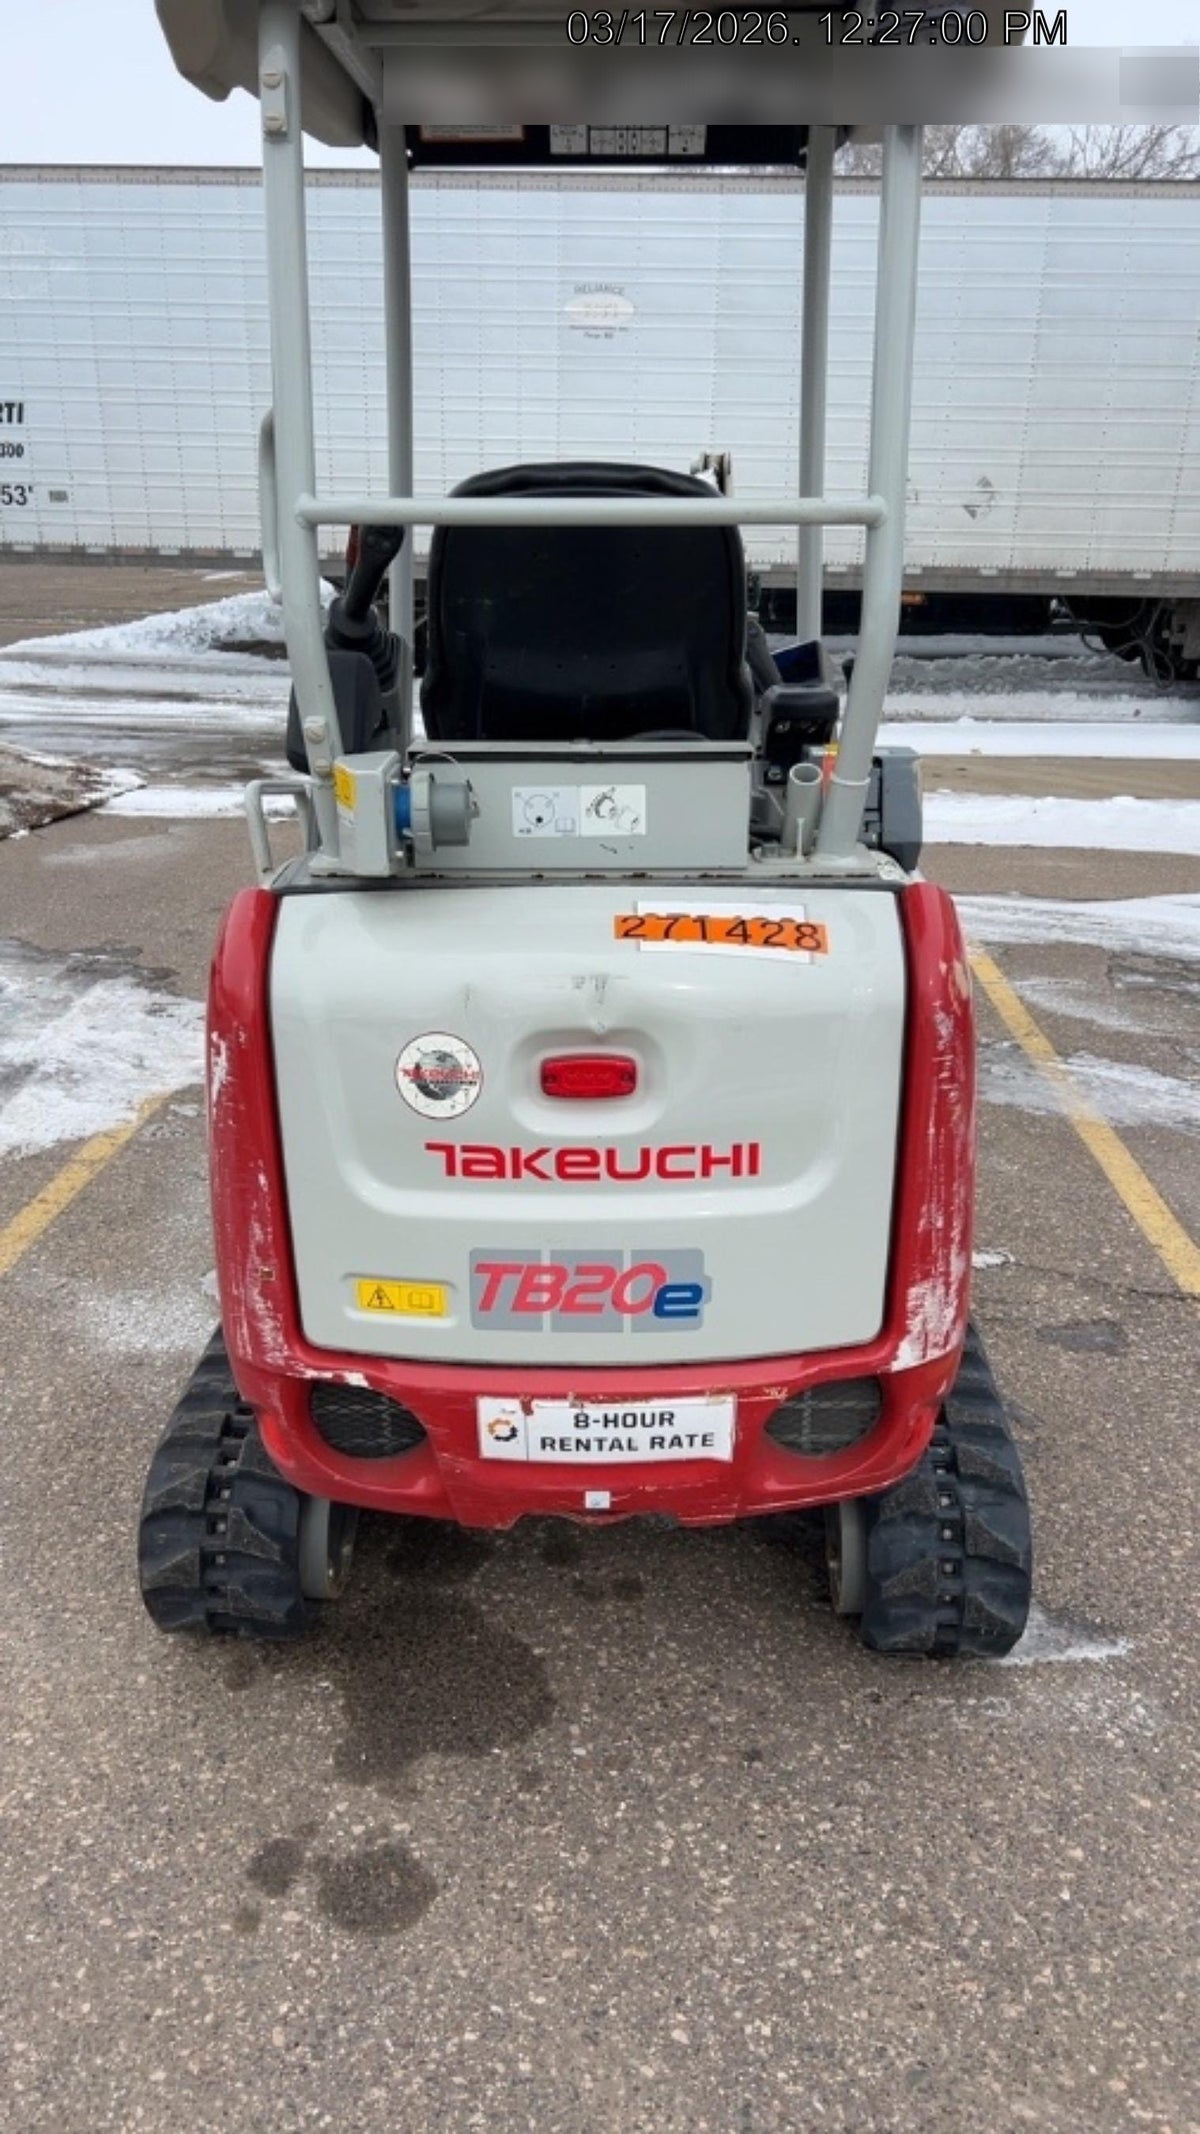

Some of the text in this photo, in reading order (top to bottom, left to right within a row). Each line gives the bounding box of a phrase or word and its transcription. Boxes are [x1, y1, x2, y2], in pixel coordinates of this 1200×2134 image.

[620, 914, 822, 951] 271428
[573, 1411, 675, 1429] 8-HOUR
[540, 1433, 715, 1452] RENTAL RATE
